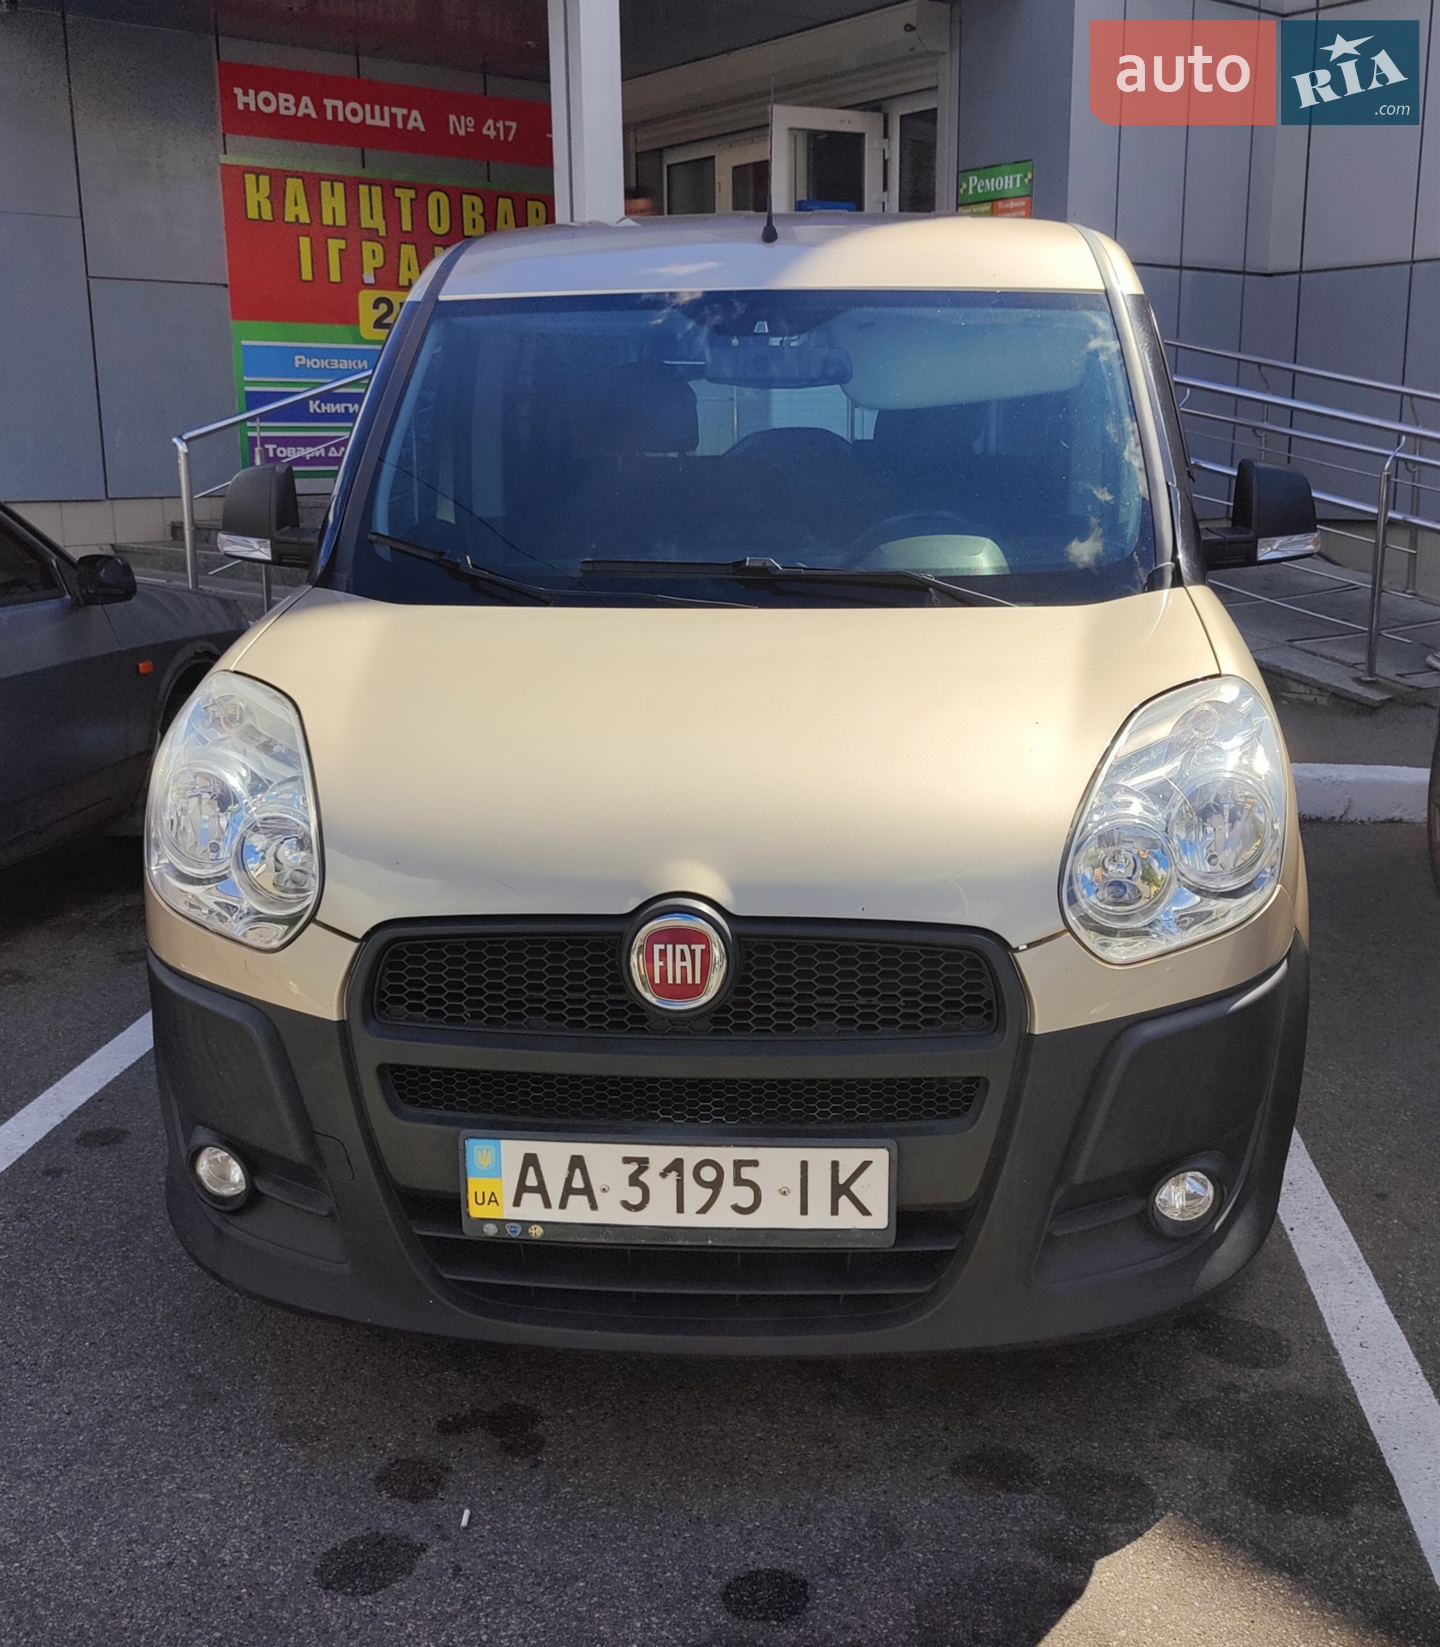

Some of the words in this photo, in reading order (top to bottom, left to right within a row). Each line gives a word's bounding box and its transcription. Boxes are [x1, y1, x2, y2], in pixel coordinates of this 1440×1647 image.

[233, 86, 317, 119] НОВА
[323, 98, 426, 132] ПОШТА
[449, 114, 475, 136] №
[482, 119, 517, 142] 417
[968, 173, 1024, 195] Ремонт
[243, 172, 547, 237] КАНЦТОВАР
[298, 235, 446, 287] ІГРА
[372, 296, 404, 330] 2
[294, 355, 368, 370] Рюкзаки
[308, 399, 359, 414] Книги
[264, 444, 325, 460] Товари
[653, 943, 706, 984] FIAT
[474, 1190, 499, 1207] UA
[512, 1152, 599, 1211] AA
[619, 1156, 762, 1215] 3195
[799, 1159, 873, 1217] IK
